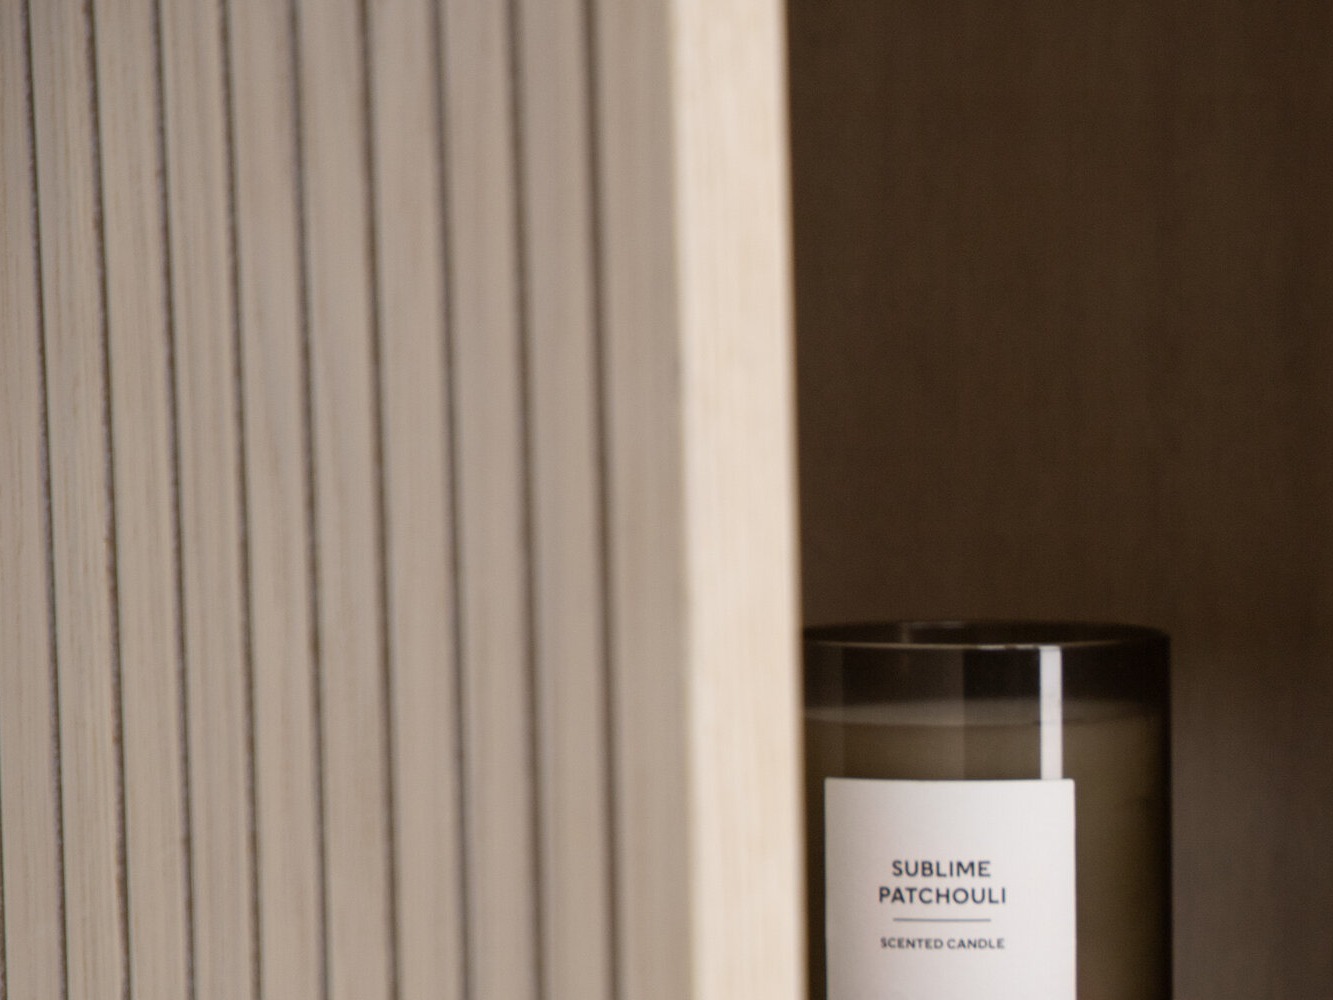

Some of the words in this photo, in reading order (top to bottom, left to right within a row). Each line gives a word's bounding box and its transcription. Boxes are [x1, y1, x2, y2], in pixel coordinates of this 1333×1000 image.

[892, 860, 991, 878] SUBLIME
[878, 886, 1006, 905] PATCHOULI
[880, 937, 943, 950] SCENTED
[947, 937, 1006, 950] CANDLE
